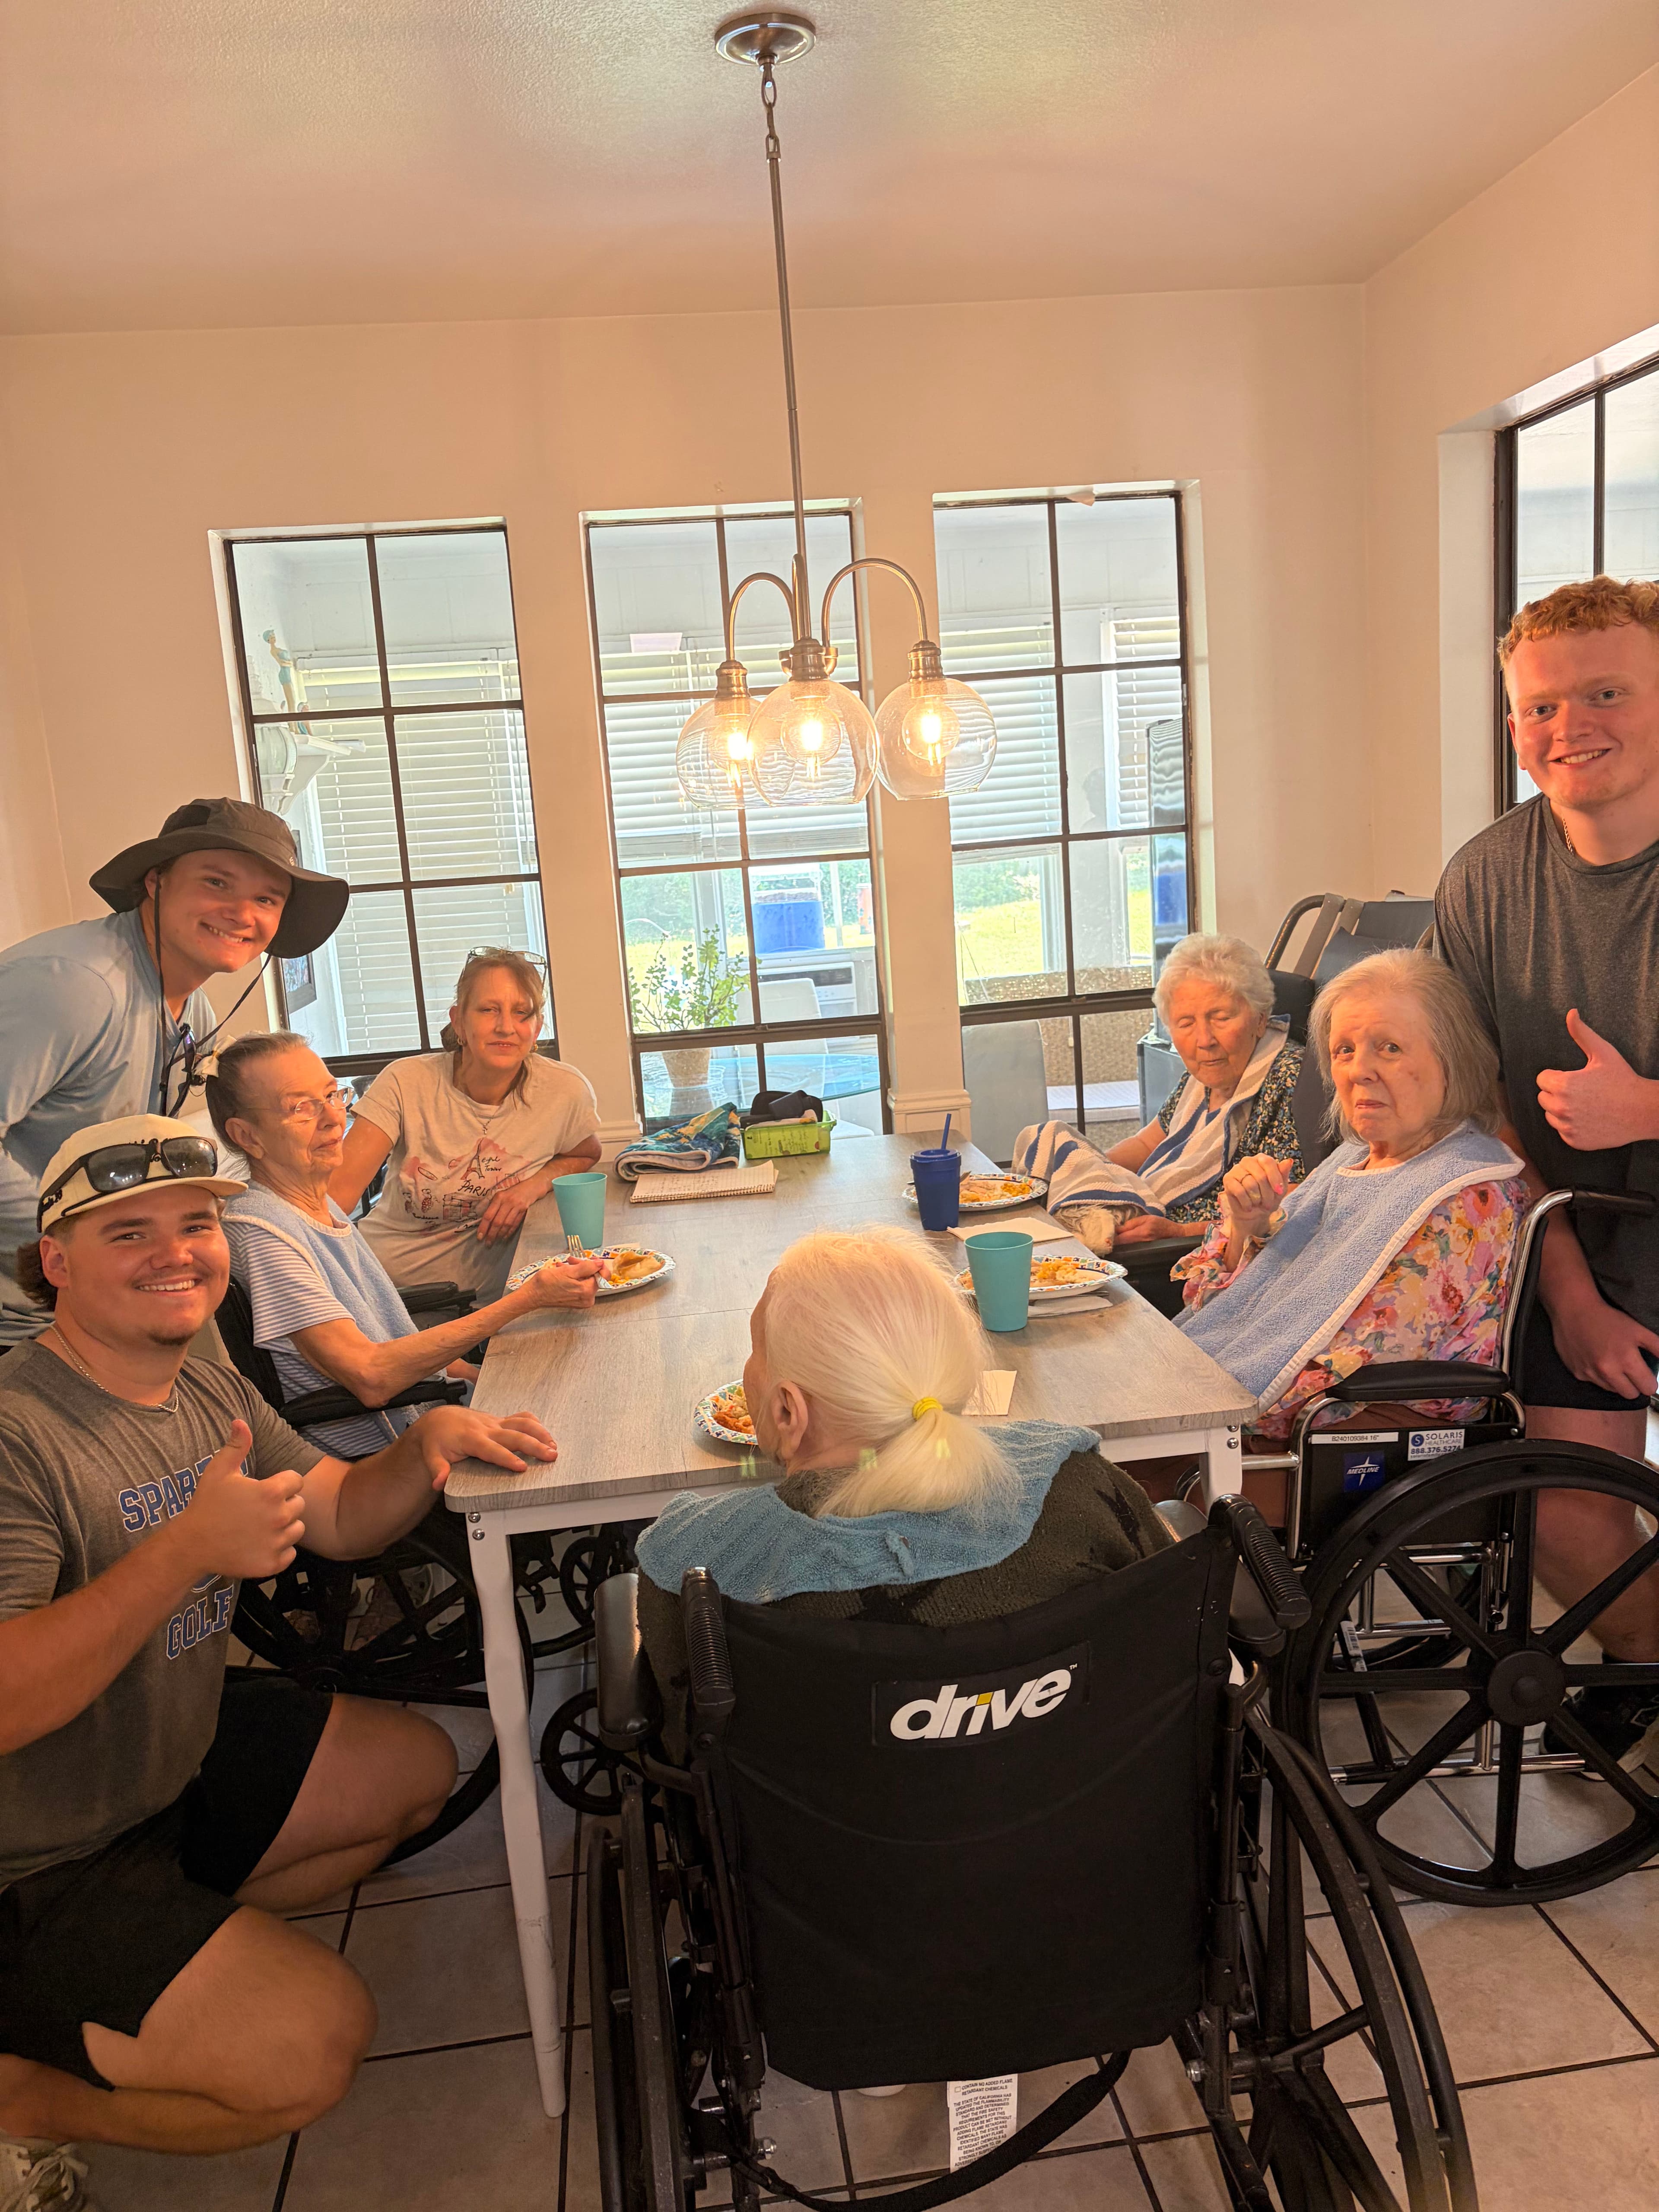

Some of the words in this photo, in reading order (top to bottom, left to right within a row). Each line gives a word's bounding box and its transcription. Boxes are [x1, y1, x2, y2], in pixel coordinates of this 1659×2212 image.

[458, 1179, 490, 1196] PARIS
[1426, 1431, 1462, 1440] SOLARIS
[1411, 1445, 1460, 1454] 888.376.5274
[166, 1585, 234, 1660] GOLF
[890, 1669, 1072, 1740] drive
[956, 2103, 972, 2111] UPDATED
[956, 2107, 975, 2116] STANDARD
[959, 2114, 987, 2125] REQUIREMENTS
[953, 2123, 970, 2132] PRODUCT
[958, 2141, 979, 2151] RETARDANT
[980, 2136, 1001, 2145] CHEMICALS
[960, 2136, 980, 2145] IDENTIFIED
[959, 2152, 978, 2161] STRONGLY
